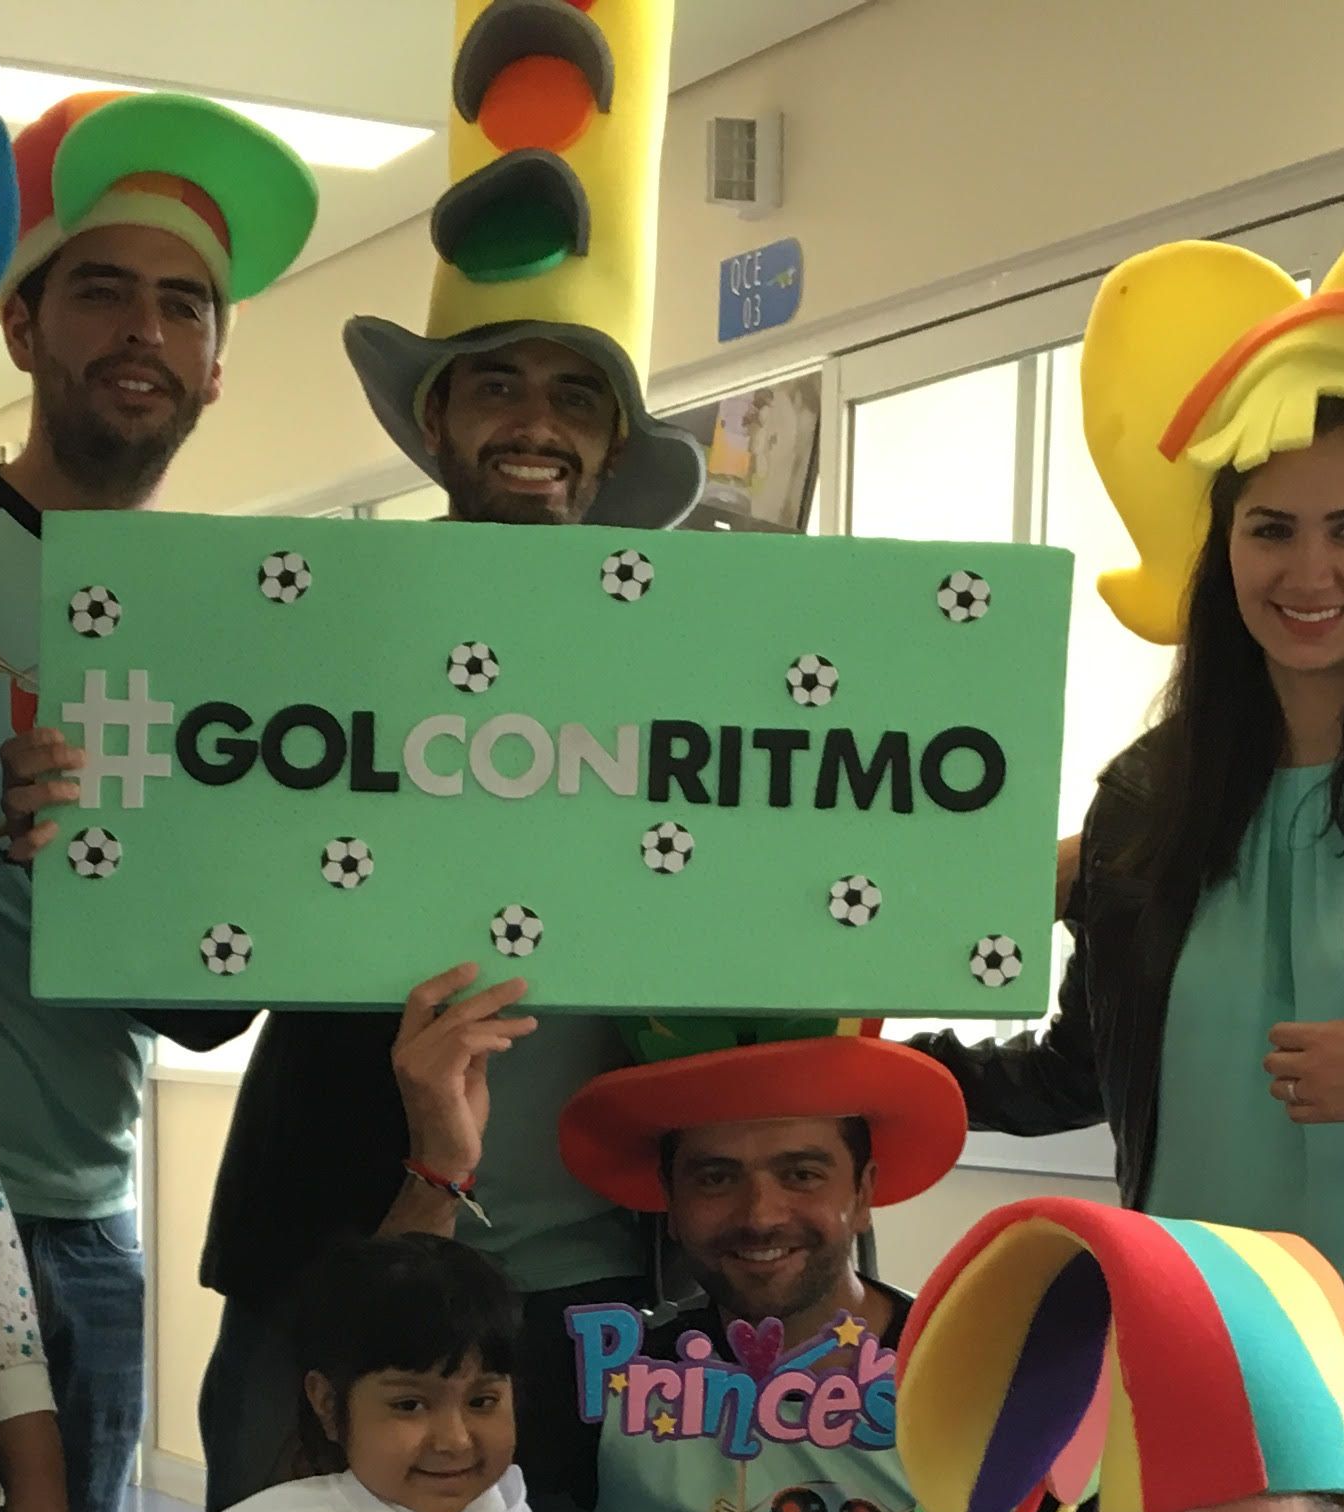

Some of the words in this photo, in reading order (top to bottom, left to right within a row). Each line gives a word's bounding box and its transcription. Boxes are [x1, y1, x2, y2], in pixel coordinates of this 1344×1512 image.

[742, 294, 761, 329] 03
[61, 669, 1008, 814] #GOLCONRITMO
[568, 1304, 897, 1456] Princes
